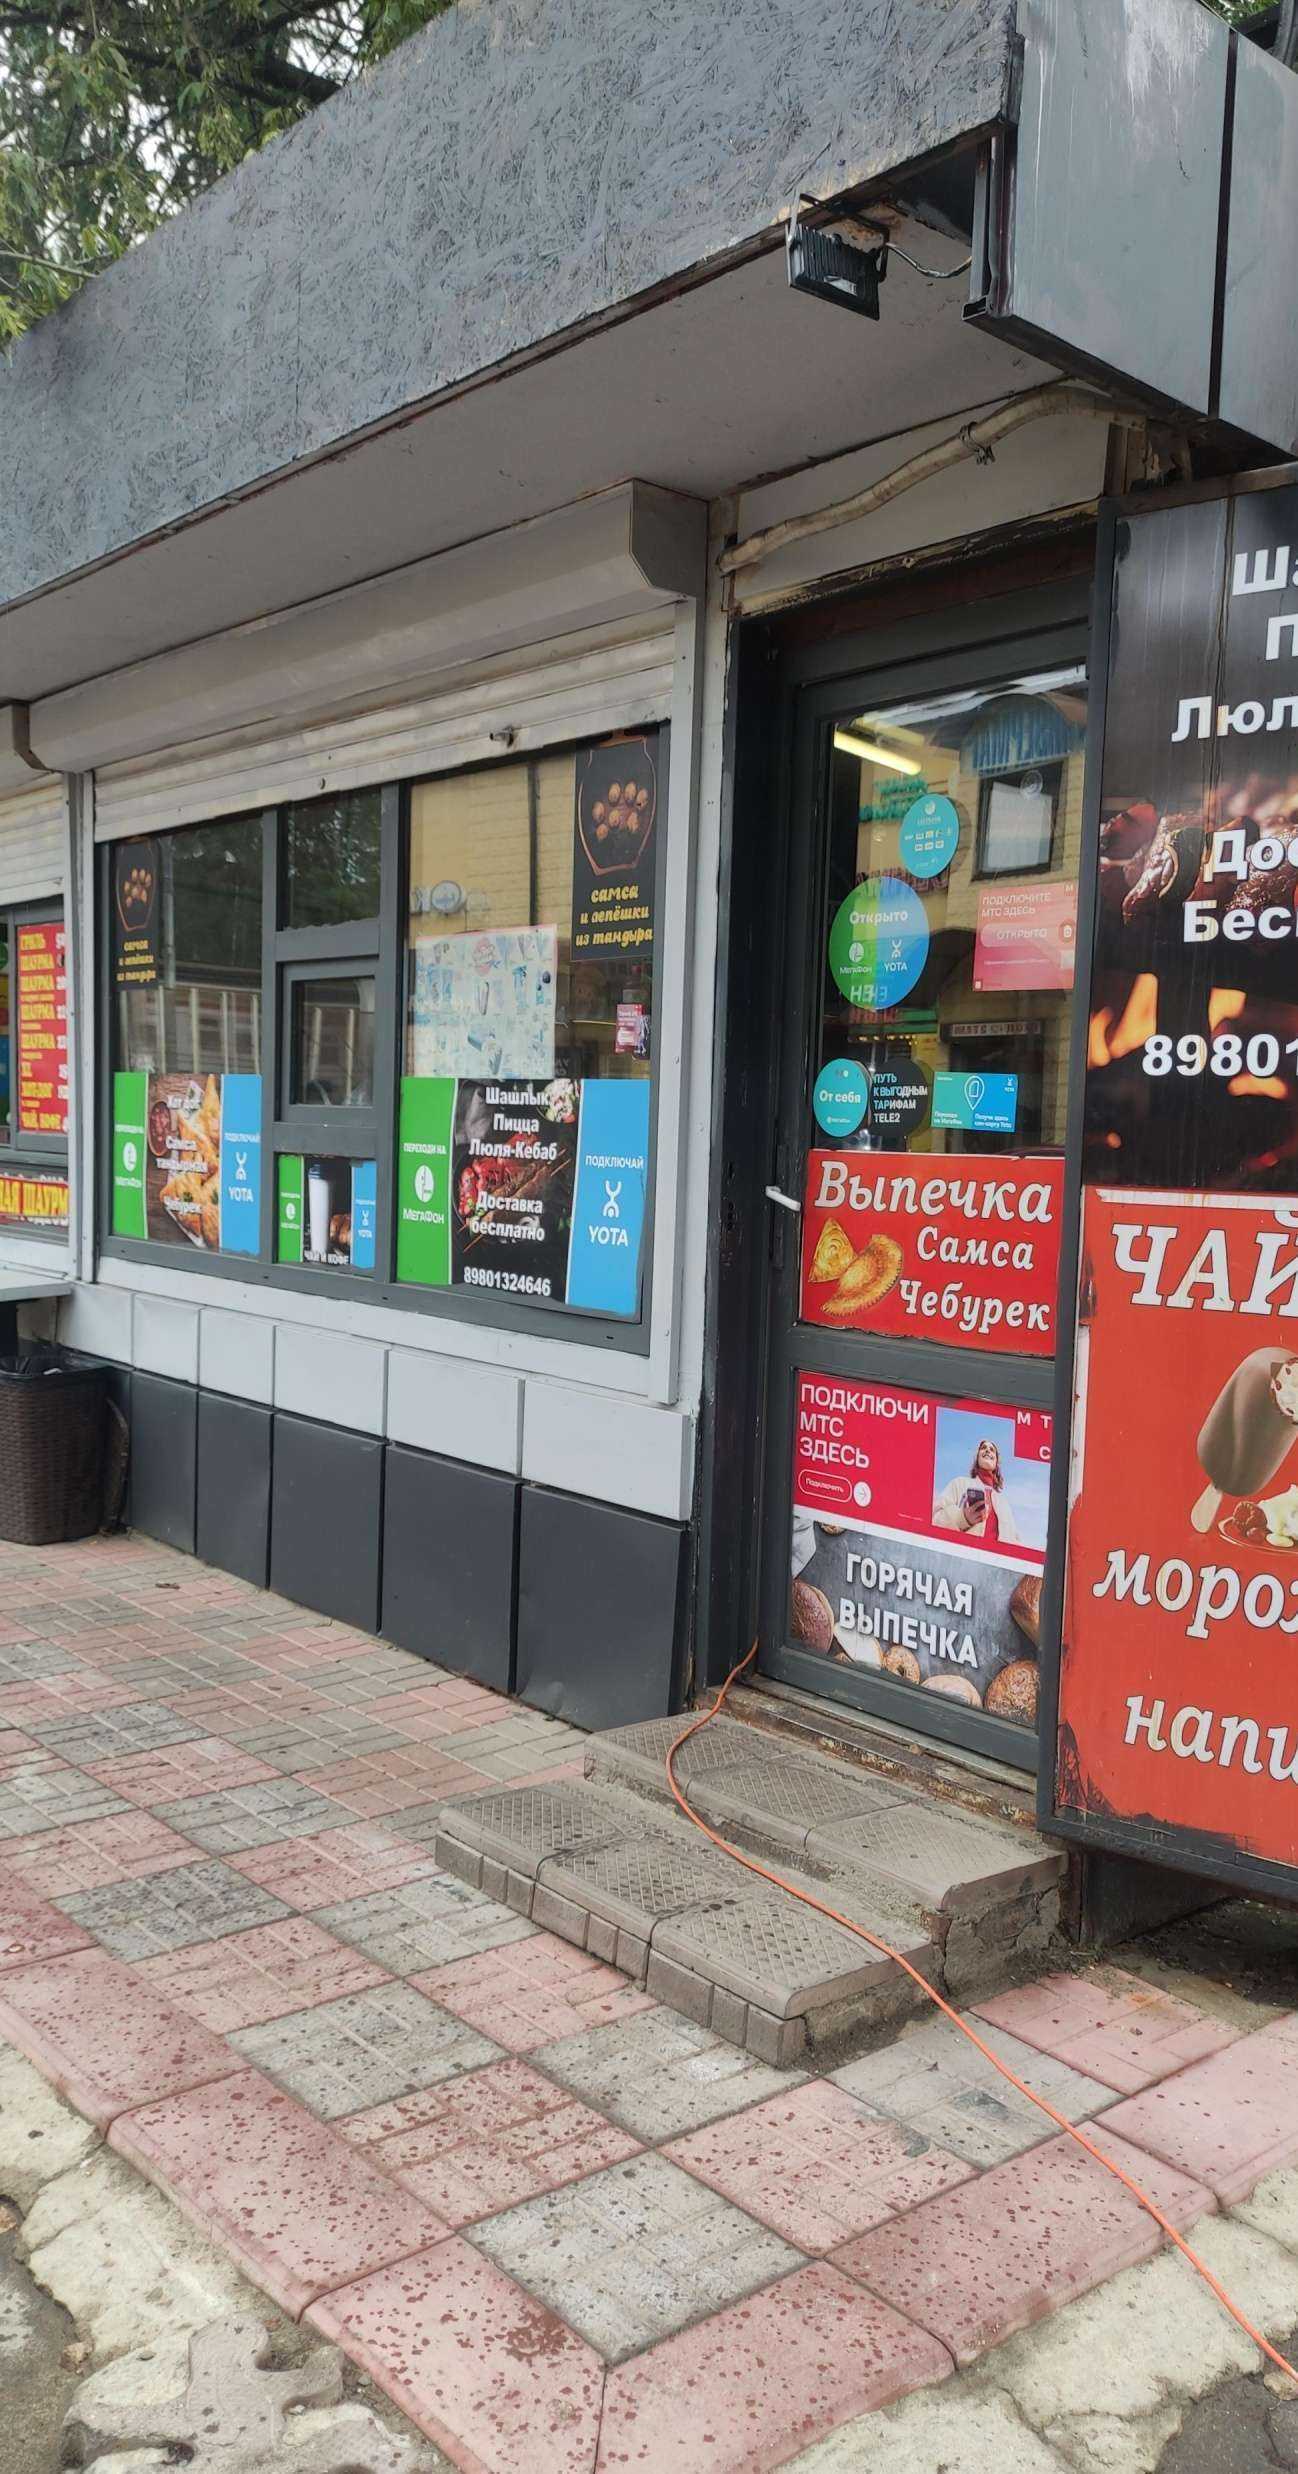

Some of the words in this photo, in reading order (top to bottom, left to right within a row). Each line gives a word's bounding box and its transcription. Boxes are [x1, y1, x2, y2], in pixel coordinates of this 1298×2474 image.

[1232, 546, 1298, 596] Ш
[591, 885, 639, 903] самса
[982, 892, 1051, 907] ПОДКЛЮЧИТЕ
[580, 912, 588, 924] и
[592, 905, 649, 923] лепёшки
[849, 910, 909, 927] Открыто
[982, 907, 1002, 918] МТС
[1003, 906, 1036, 919] ЗДЕСЬ
[576, 933, 589, 947] из
[592, 927, 653, 948] тандыра
[996, 927, 1048, 940] ОТКРЫТО
[884, 961, 908, 973] YOTA
[874, 1073, 897, 1084] ПУТЬ
[486, 1087, 551, 1106] Шашлык
[819, 1090, 834, 1103] От
[835, 1091, 861, 1104] себя
[880, 1086, 928, 1097] ВЫГОДНЫМ
[874, 1099, 916, 1110] ТАРИФАМ
[493, 1113, 539, 1134] Пицца
[874, 1113, 900, 1123] TELE2
[469, 1139, 557, 1161] Люля-Кебаб
[585, 1155, 644, 1169] ПОДКЛЮЧАЙ
[228, 1187, 253, 1202] YOTA
[814, 1160, 1053, 1224] Выпечка
[476, 1192, 543, 1215] Доставка
[471, 1217, 545, 1241] бесплатно
[588, 1225, 628, 1247] YOTA
[917, 1225, 1034, 1271] Самса
[463, 1266, 550, 1296] 89801324646
[900, 1278, 1051, 1334] Чебурек
[800, 1383, 929, 1425] ПОДКЛЮЧИ
[800, 1411, 844, 1438] МТС
[799, 1436, 870, 1469] ЗДЕСЬ
[806, 1477, 845, 1494] Подключить
[846, 1552, 974, 1617] ГОРЯЧАЯ
[839, 1597, 979, 1669] ВЫПЕЧКА
